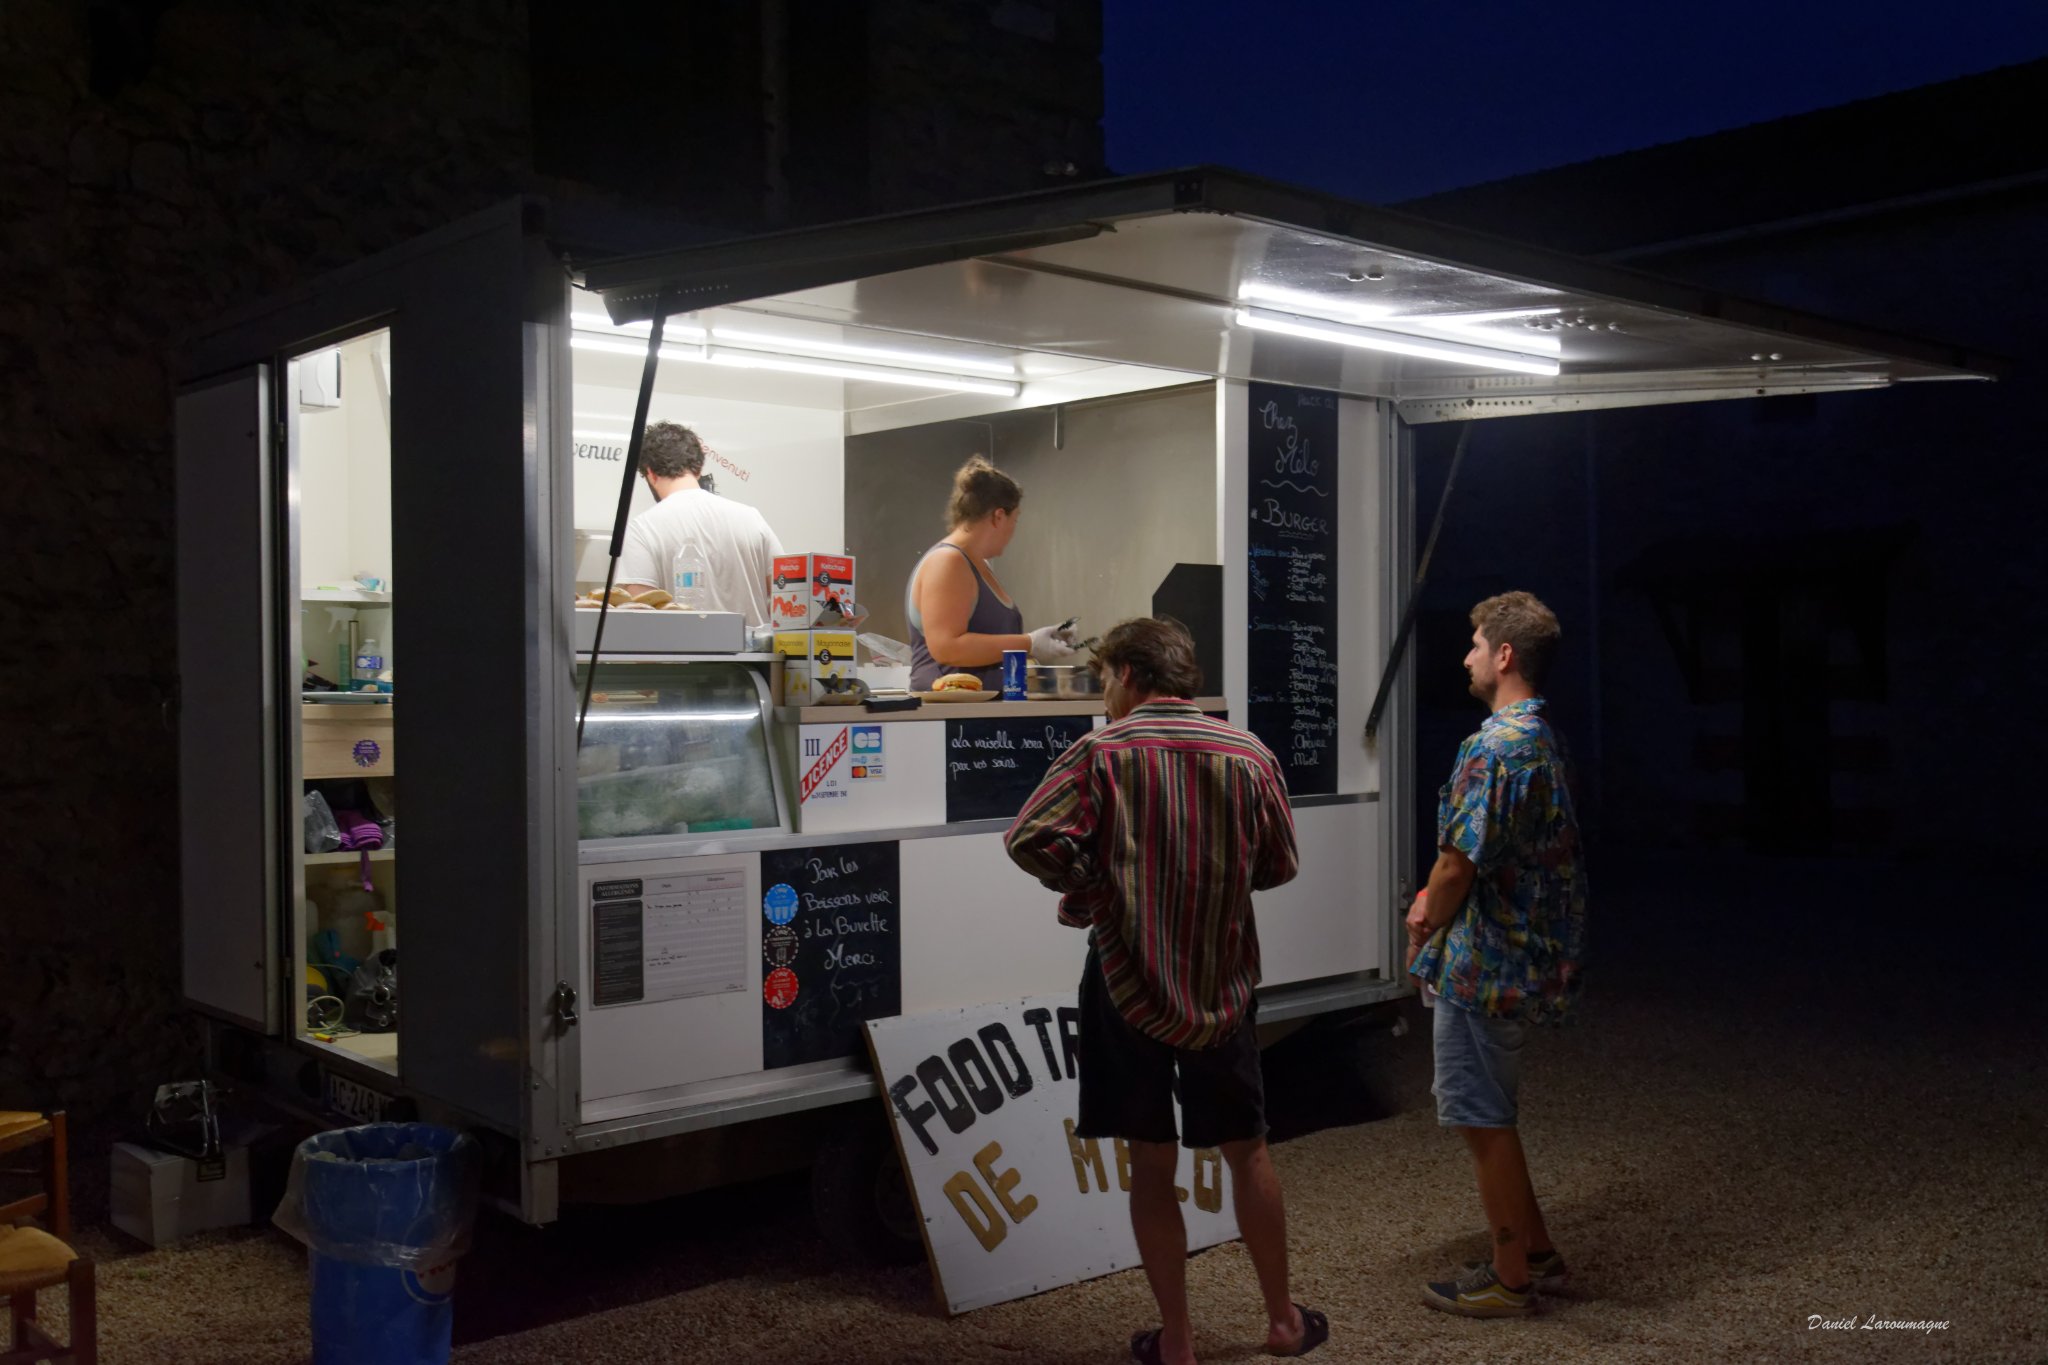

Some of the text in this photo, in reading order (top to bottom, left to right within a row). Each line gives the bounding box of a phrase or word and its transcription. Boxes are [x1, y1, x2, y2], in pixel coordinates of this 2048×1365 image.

[1259, 400, 1298, 449] Chez
[800, 731, 847, 799] LICENCE
[804, 738, 820, 756] III
[888, 1021, 1034, 1156] FOOD
[942, 1140, 1039, 1252] DE
